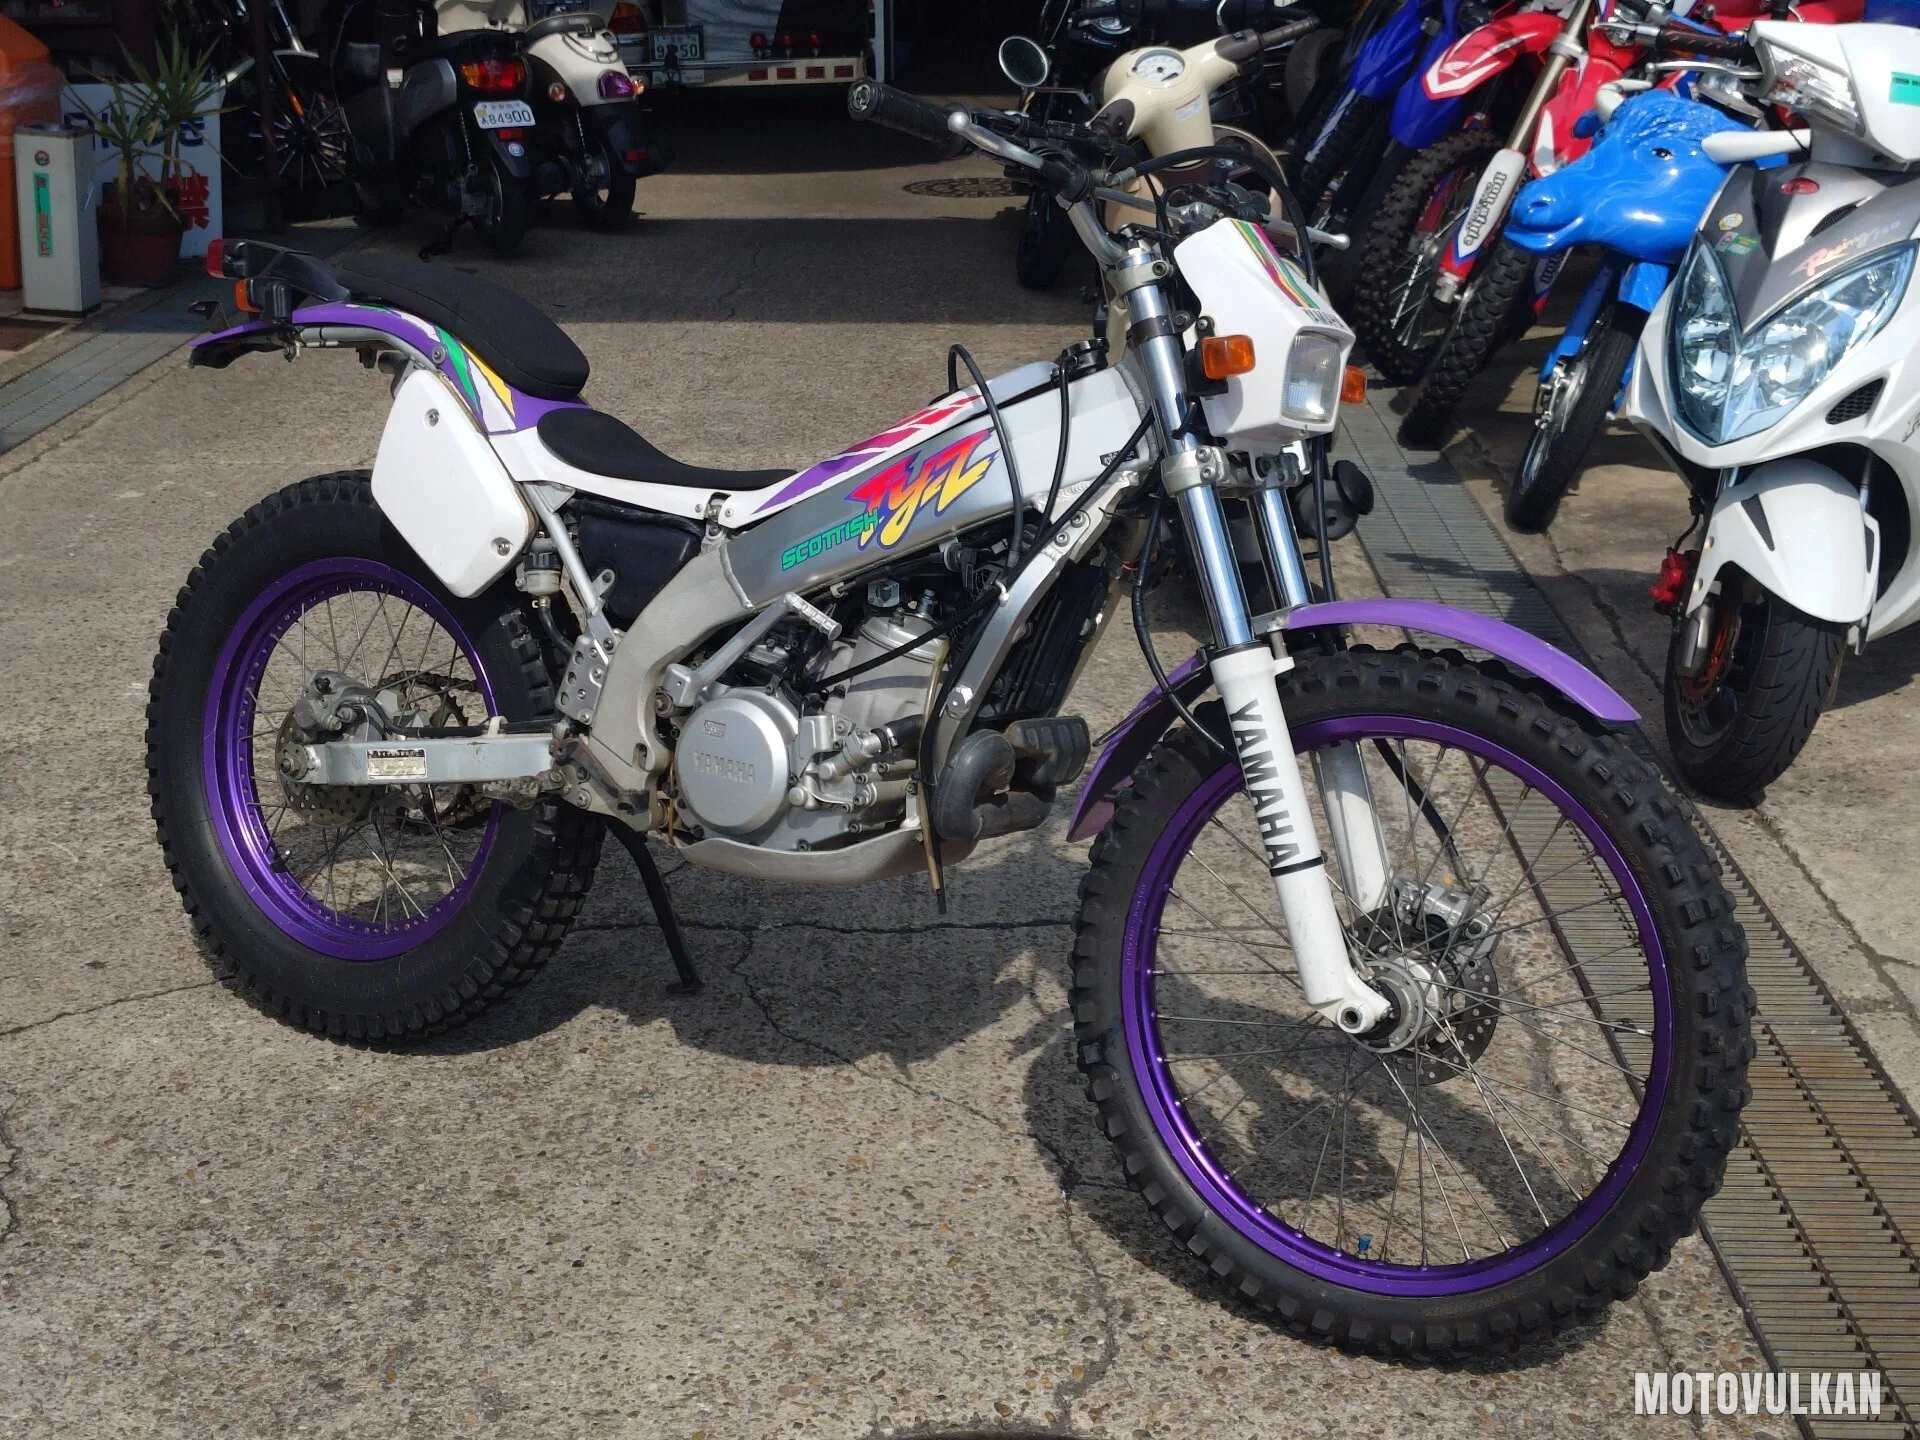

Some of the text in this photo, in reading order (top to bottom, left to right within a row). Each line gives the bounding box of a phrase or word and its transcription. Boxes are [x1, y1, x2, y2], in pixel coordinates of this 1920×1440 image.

[781, 507, 880, 571] SCOTTISH
[692, 750, 756, 785] YAMAHA
[1229, 698, 1302, 868] YAMAHA
